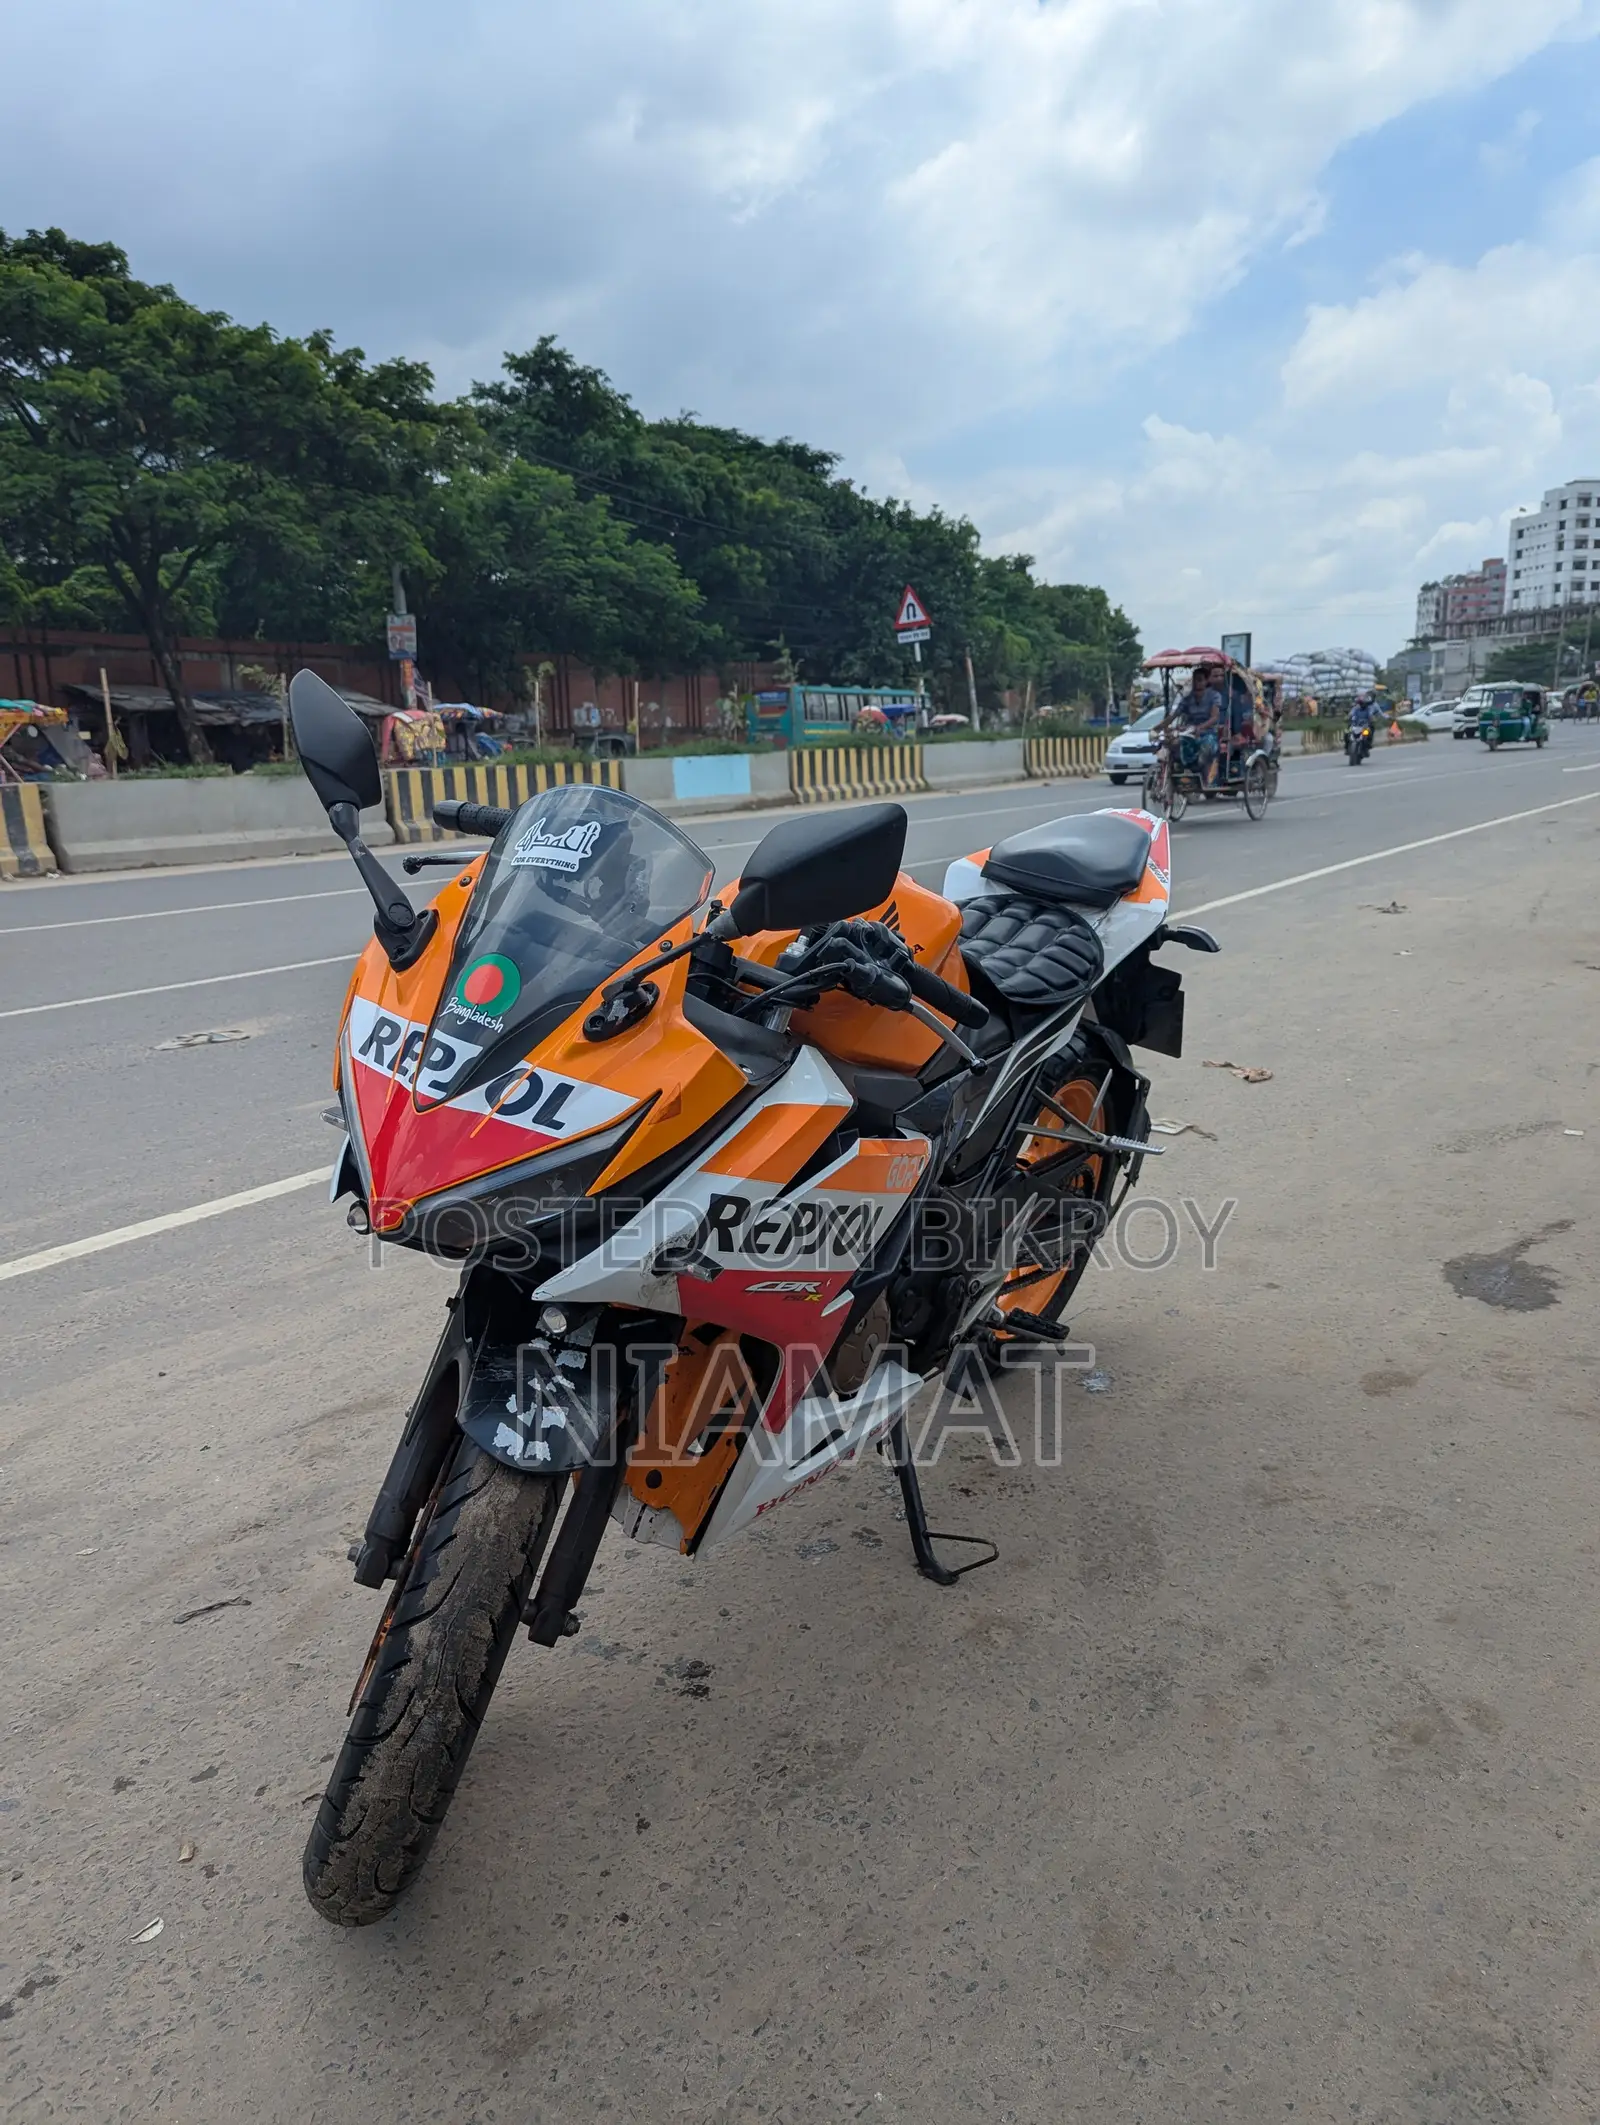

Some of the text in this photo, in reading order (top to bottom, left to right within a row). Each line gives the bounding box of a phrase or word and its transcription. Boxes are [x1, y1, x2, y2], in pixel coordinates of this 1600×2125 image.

[513, 856, 577, 870] FOR EVERYTHING
[439, 996, 504, 1034] Bangladesh
[687, 1192, 884, 1257] REPSOL
[744, 1281, 822, 1293] CBR
